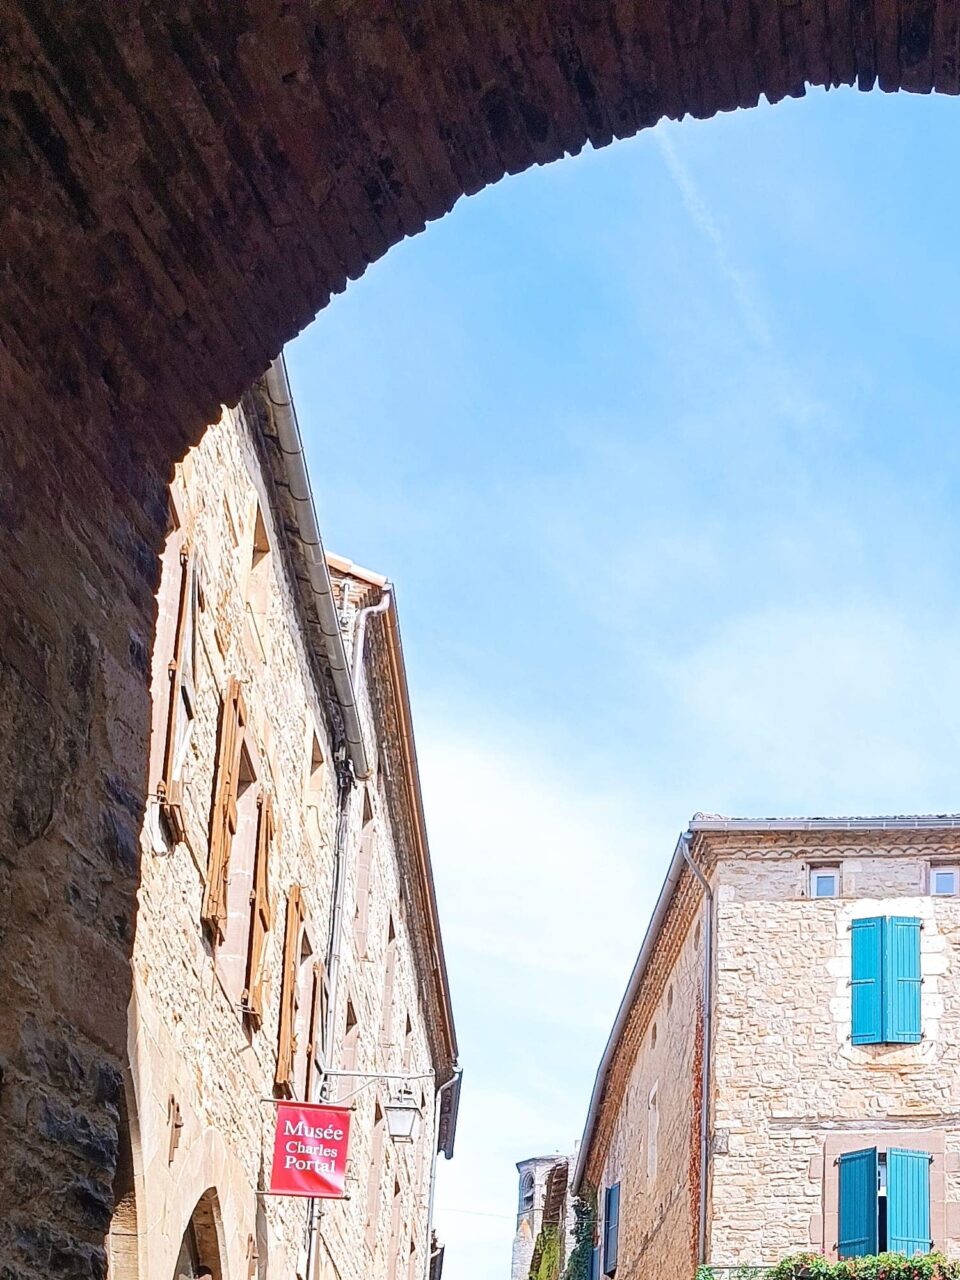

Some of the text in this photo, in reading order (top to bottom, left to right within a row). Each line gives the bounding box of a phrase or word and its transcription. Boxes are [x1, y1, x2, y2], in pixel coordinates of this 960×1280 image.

[283, 1120, 344, 1141] Musée
[285, 1141, 338, 1158] Charles
[284, 1155, 336, 1173] Portal
